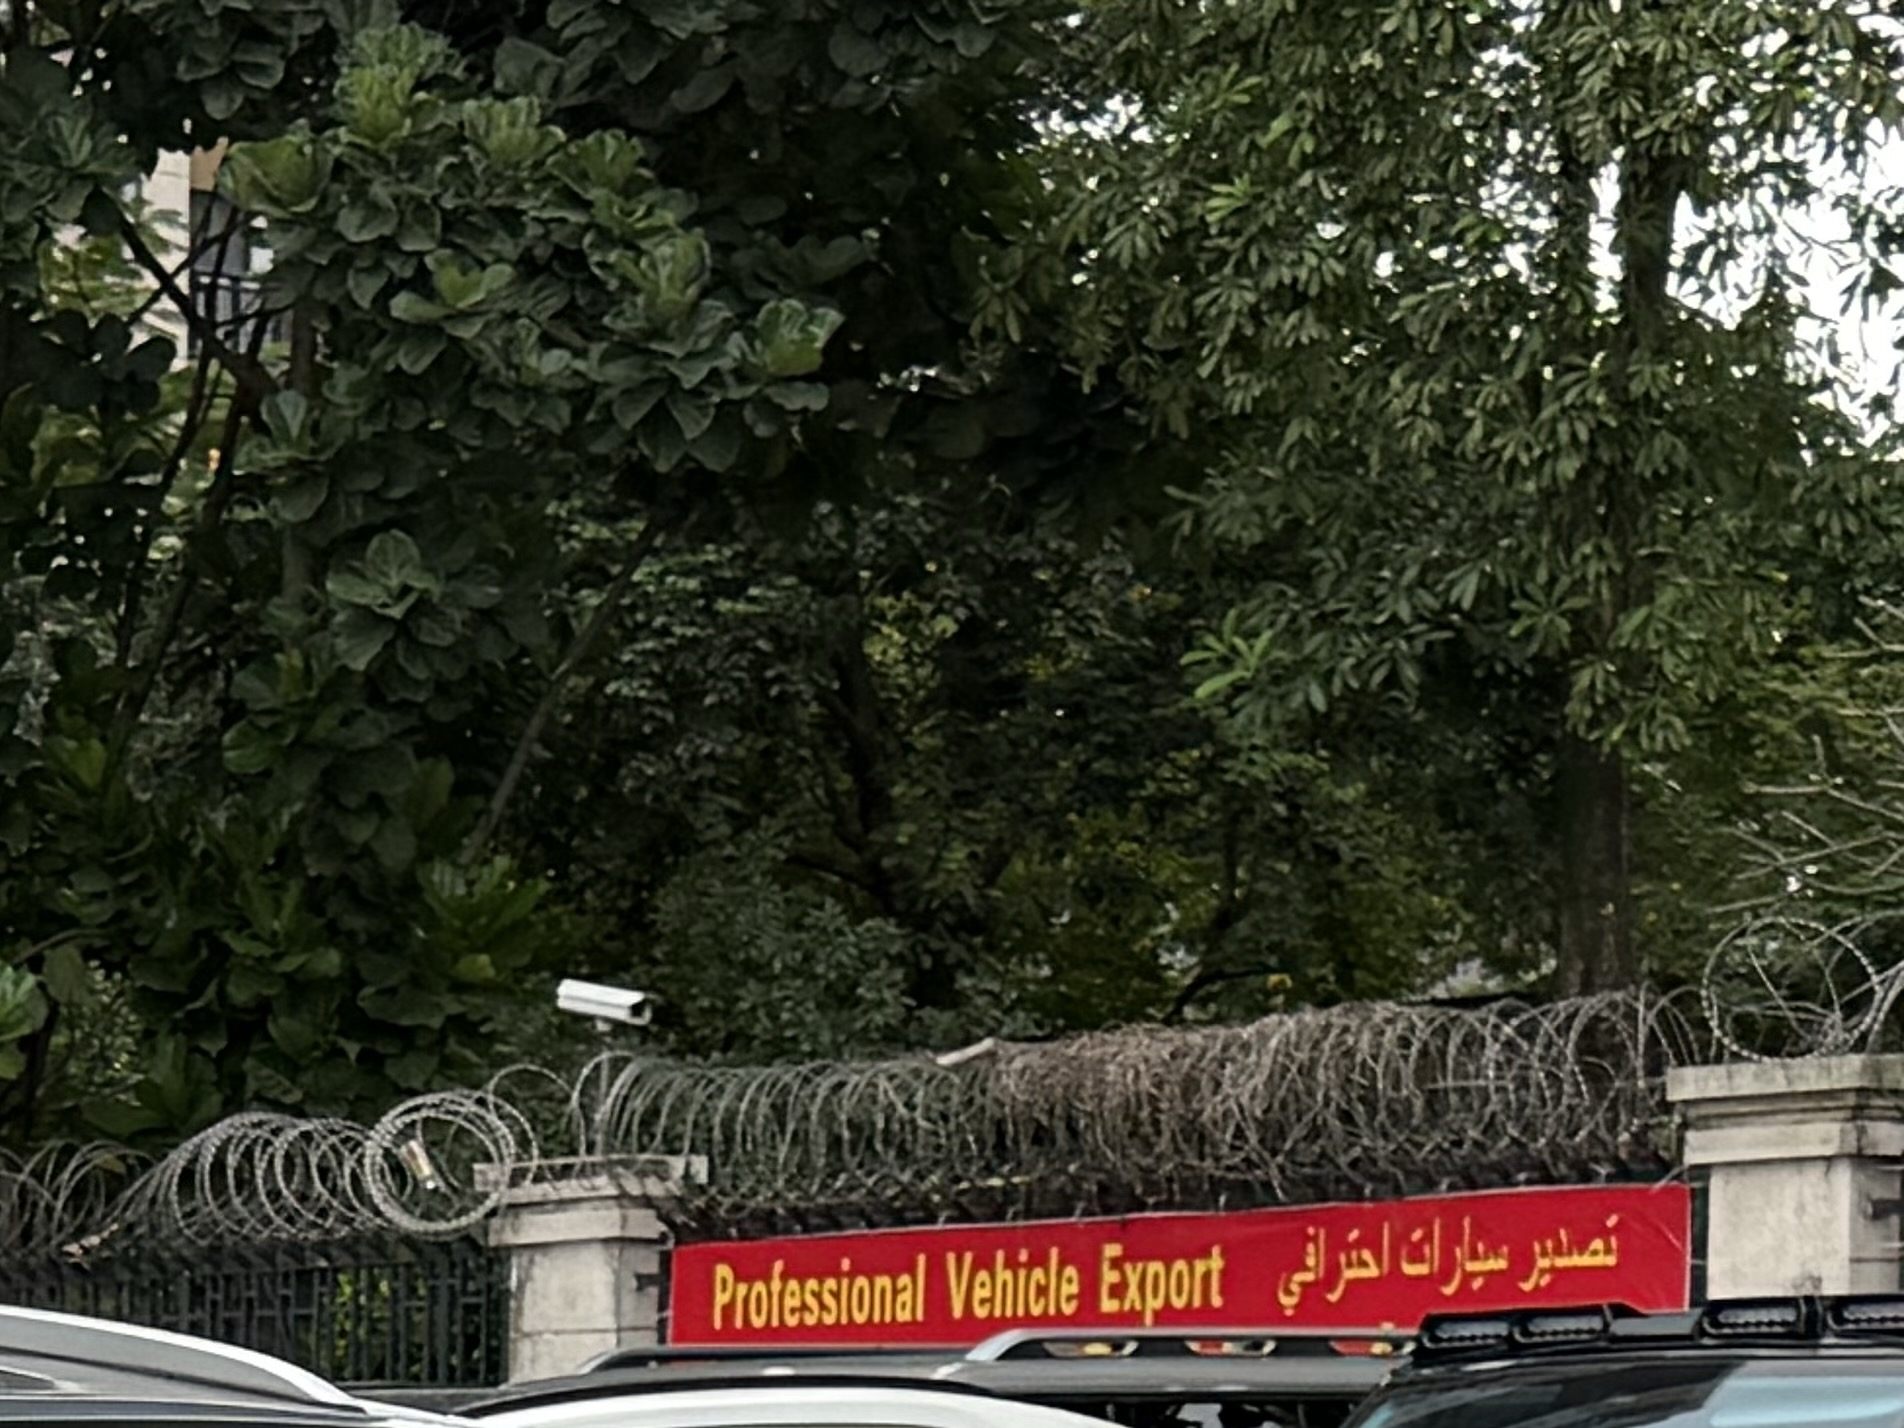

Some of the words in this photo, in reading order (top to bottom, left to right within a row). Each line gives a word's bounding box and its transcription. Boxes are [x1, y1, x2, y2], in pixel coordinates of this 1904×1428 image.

[712, 1252, 926, 1331] Professional
[946, 1245, 1080, 1320] Vehicle
[1099, 1241, 1225, 1327] Export
[1277, 1219, 1389, 1317] احترافي
[1400, 1214, 1509, 1296] سيارات
[1518, 1213, 1620, 1293] تصدير
